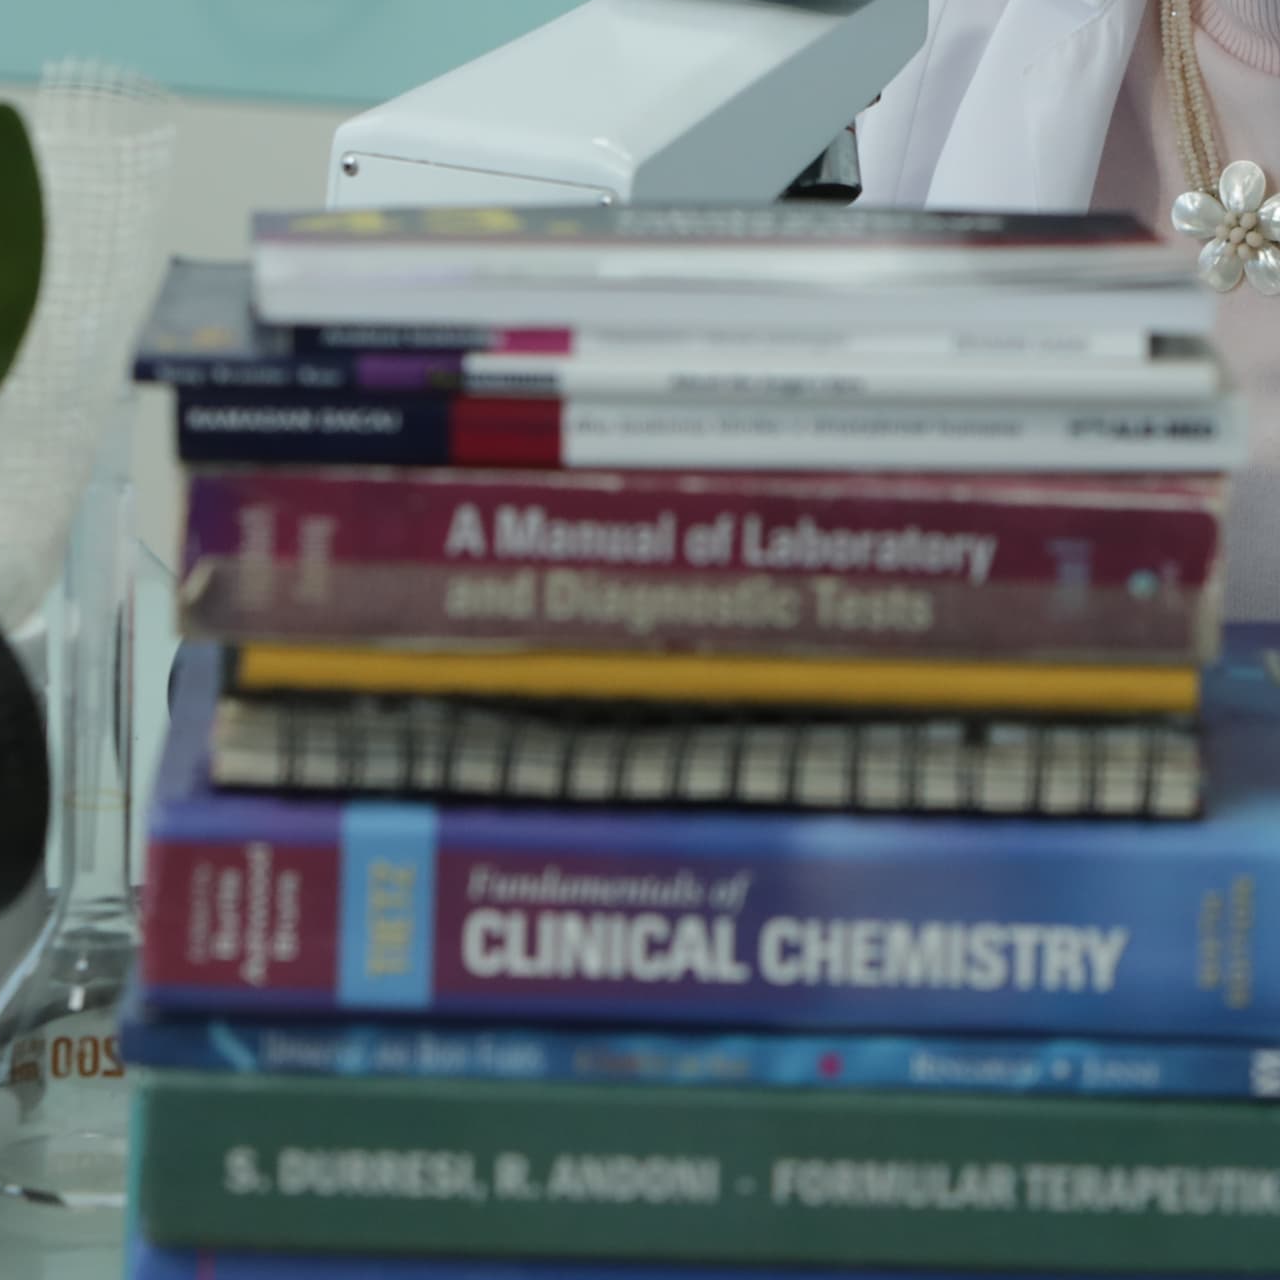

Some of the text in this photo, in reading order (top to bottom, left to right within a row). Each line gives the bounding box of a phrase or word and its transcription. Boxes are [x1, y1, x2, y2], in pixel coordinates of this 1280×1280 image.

[446, 503, 485, 558] A
[494, 505, 676, 562] Manual
[683, 512, 735, 566] of
[742, 513, 997, 586] Laboratory
[446, 569, 933, 634] and Diagnostic Tests
[465, 862, 751, 912] Fundamentals of
[462, 908, 1128, 991] CLINICAL CHEMISTRY
[224, 1147, 271, 1195] S.
[494, 1152, 541, 1201] R.
[546, 1154, 721, 1205] ANDONI
[772, 1158, 1019, 1212] FORMULAR
